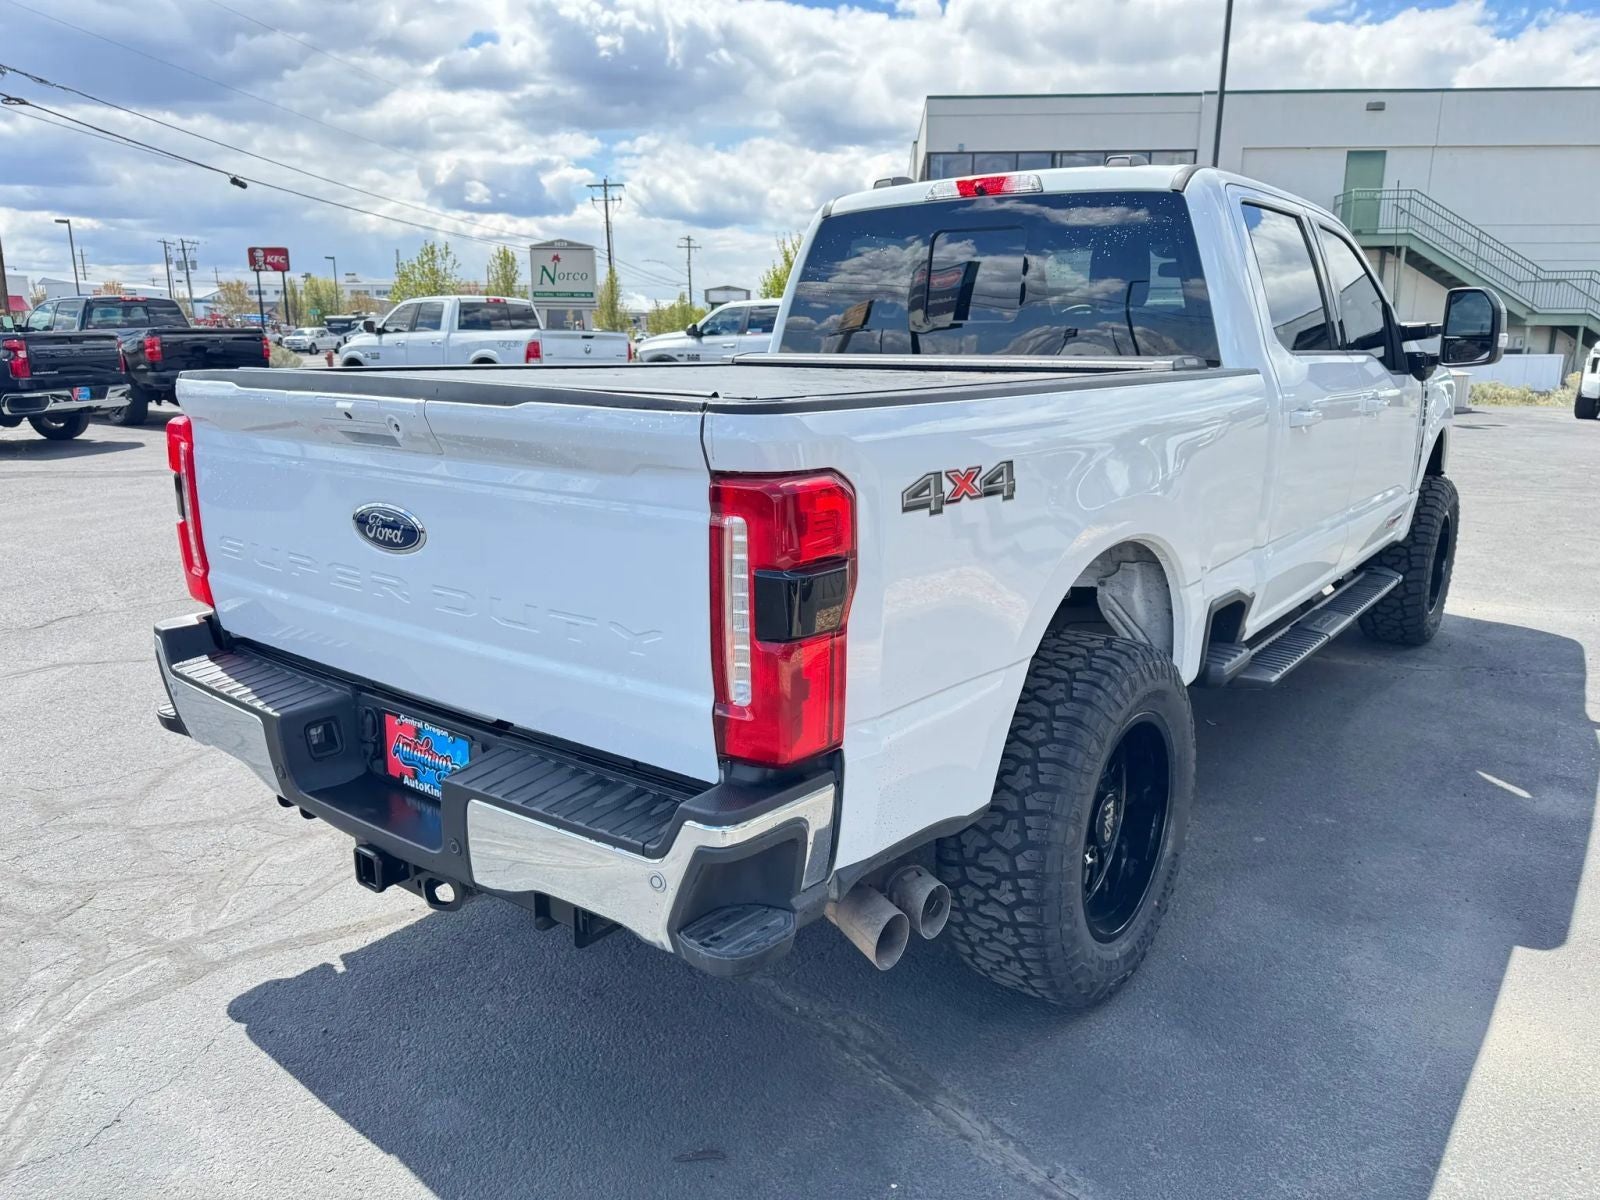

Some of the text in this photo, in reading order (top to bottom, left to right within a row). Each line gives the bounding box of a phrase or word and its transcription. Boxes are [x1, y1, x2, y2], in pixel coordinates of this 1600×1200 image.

[266, 255, 287, 264] KFC
[538, 262, 588, 286] Norco
[901, 459, 1015, 516] 4X4
[365, 512, 404, 543] Ford
[219, 535, 663, 656] SUPER DUTY
[400, 714, 449, 737] Central Oregon
